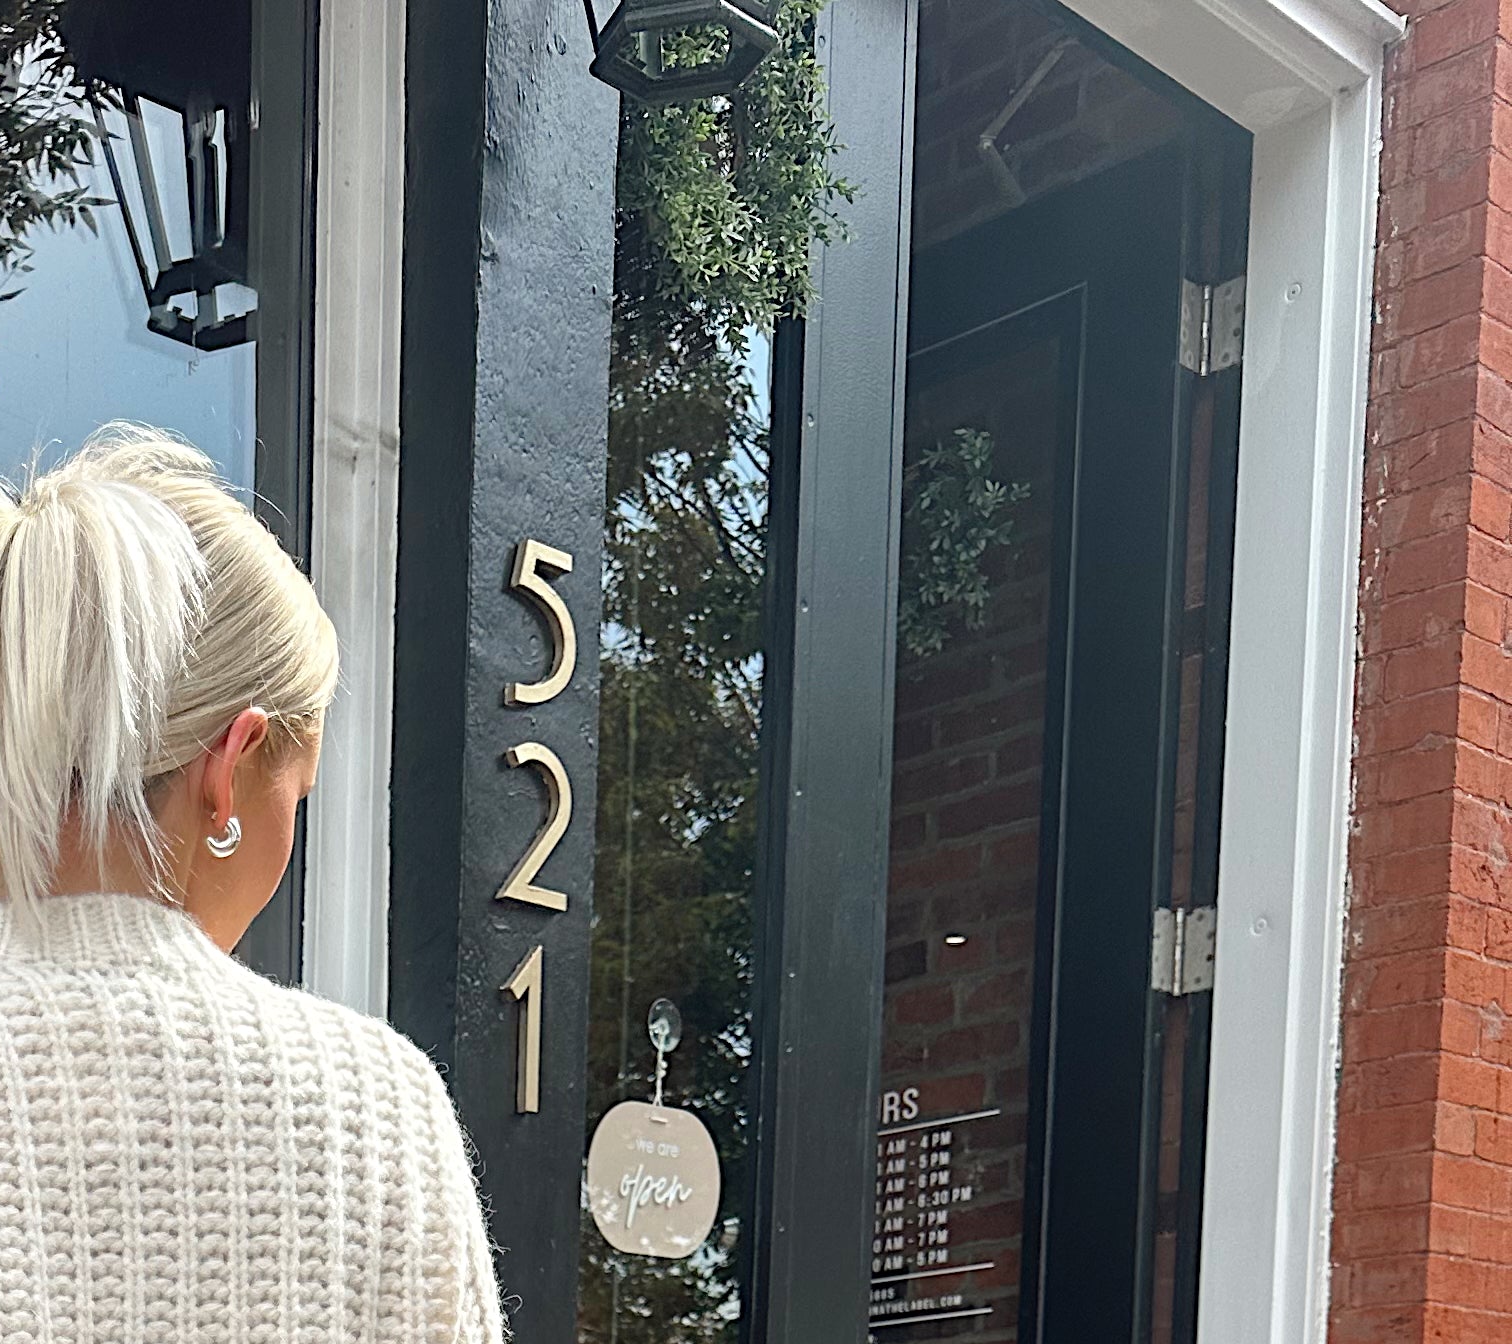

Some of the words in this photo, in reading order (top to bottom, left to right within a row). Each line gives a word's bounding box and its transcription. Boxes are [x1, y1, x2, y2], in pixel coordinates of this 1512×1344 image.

[494, 538, 577, 1114] 521
[877, 1087, 920, 1125] RS
[635, 1137, 654, 1154] we
[657, 1142, 680, 1158] are
[886, 1139, 906, 1155] AM
[920, 1135, 928, 1149] 4
[931, 1130, 952, 1148] PM
[886, 1158, 906, 1174] AM
[930, 1151, 950, 1168] PM
[885, 1177, 905, 1194] AM
[929, 1170, 950, 1187] PM
[619, 1163, 693, 1229] open
[884, 1197, 904, 1213] AM
[952, 1185, 972, 1203] PM
[883, 1216, 904, 1233] AM
[918, 1212, 926, 1228] 7
[928, 1209, 948, 1226] PM
[884, 1235, 904, 1252] AM
[918, 1232, 926, 1247] 7
[928, 1229, 948, 1246] PM
[883, 1255, 903, 1271] AM
[928, 1248, 948, 1265] PM
